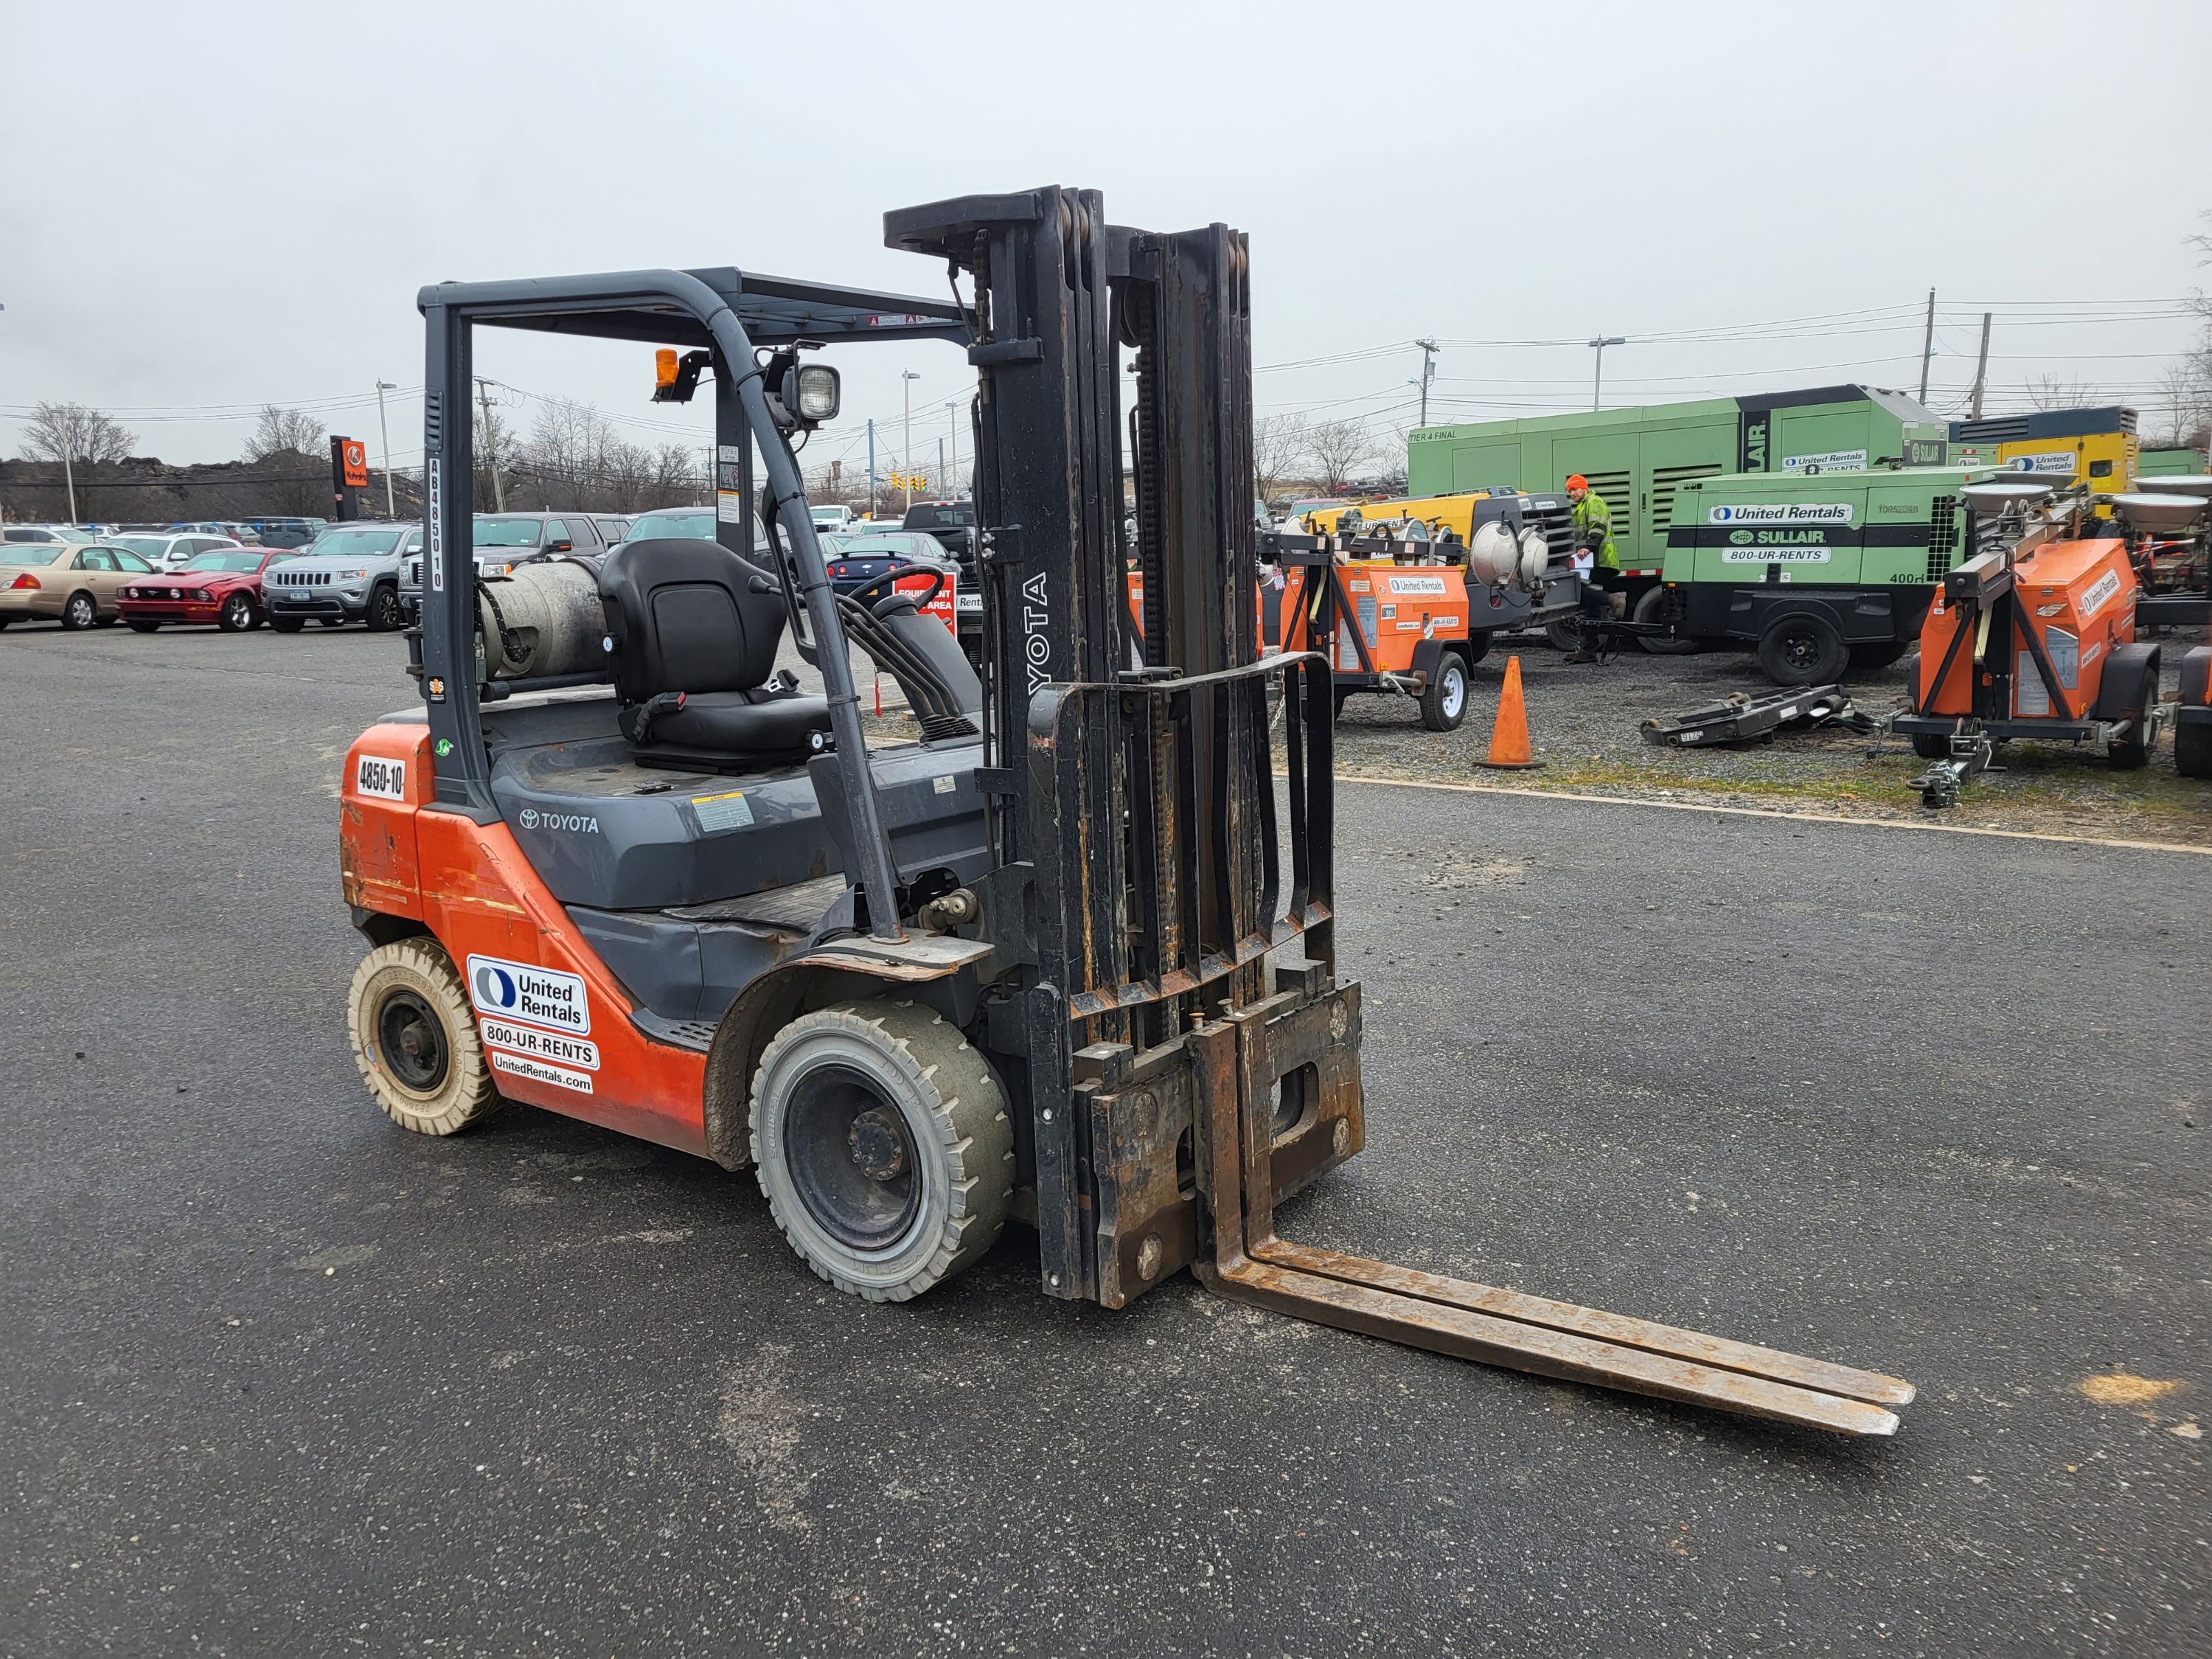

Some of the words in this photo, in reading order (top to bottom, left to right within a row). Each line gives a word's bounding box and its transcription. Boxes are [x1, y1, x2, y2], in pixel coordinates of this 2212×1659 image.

[1409, 434, 1426, 442] TIER
[1435, 430, 1457, 439] FINAL
[1748, 423, 1766, 472] LAIR
[1798, 456, 1829, 465] United
[1829, 452, 1863, 462] Rentals
[2036, 454, 2070, 464] United
[2035, 462, 2072, 471] Rentals
[1735, 507, 1784, 520] United
[1787, 506, 1845, 519] Rentals
[431, 460, 441, 587] AB485010
[1757, 530, 1825, 543] SULLAIR
[1731, 551, 1822, 560] 800-UR-RENTS
[1400, 581, 1422, 591] United
[1421, 580, 1443, 590] Rentals
[898, 590, 952, 598] EQUIPNT
[928, 601, 953, 610] AREA
[960, 597, 984, 606] Renta
[1023, 571, 1051, 695] YOTA
[360, 761, 403, 795] 4850-10
[541, 813, 599, 833] TOYOTA
[518, 974, 572, 1002] United
[521, 994, 581, 1024] Rentals
[487, 1025, 592, 1062] 800-UR-RENTS
[495, 1055, 591, 1091] UnitedRentals.com
